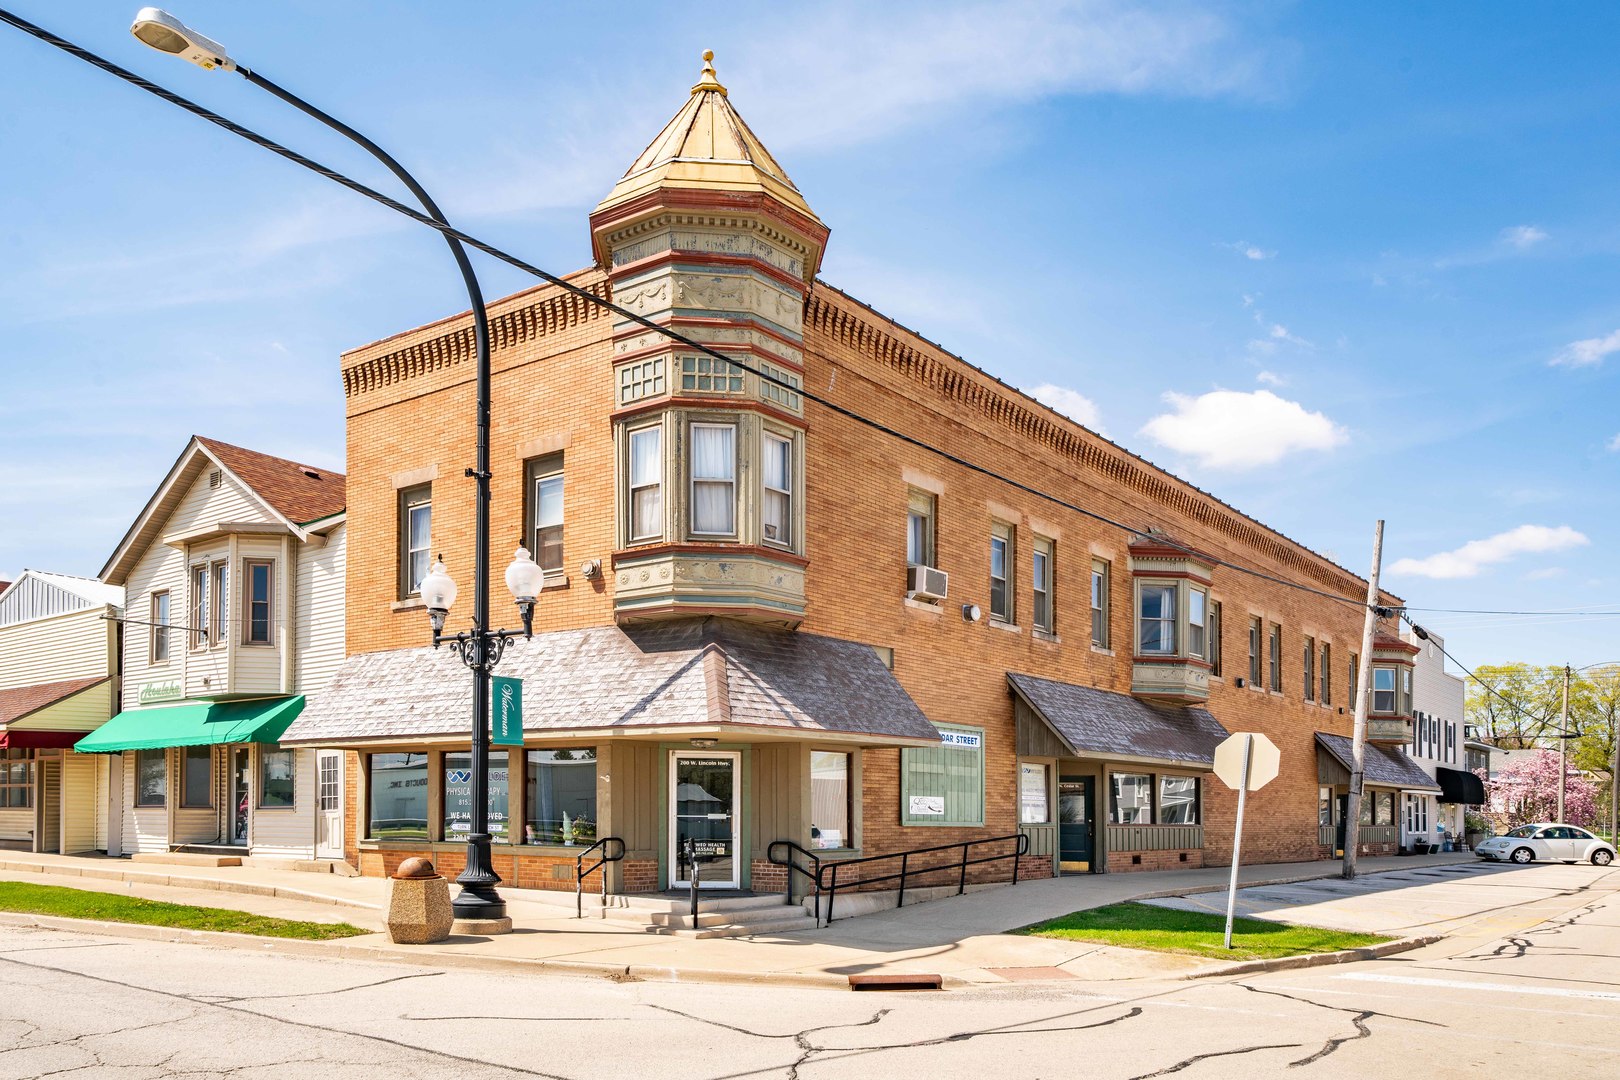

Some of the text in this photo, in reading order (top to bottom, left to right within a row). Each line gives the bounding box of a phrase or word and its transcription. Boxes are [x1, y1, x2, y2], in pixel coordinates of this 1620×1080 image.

[502, 684, 514, 736] Waterman
[956, 736, 978, 744] STREET
[488, 787, 500, 796] APY
